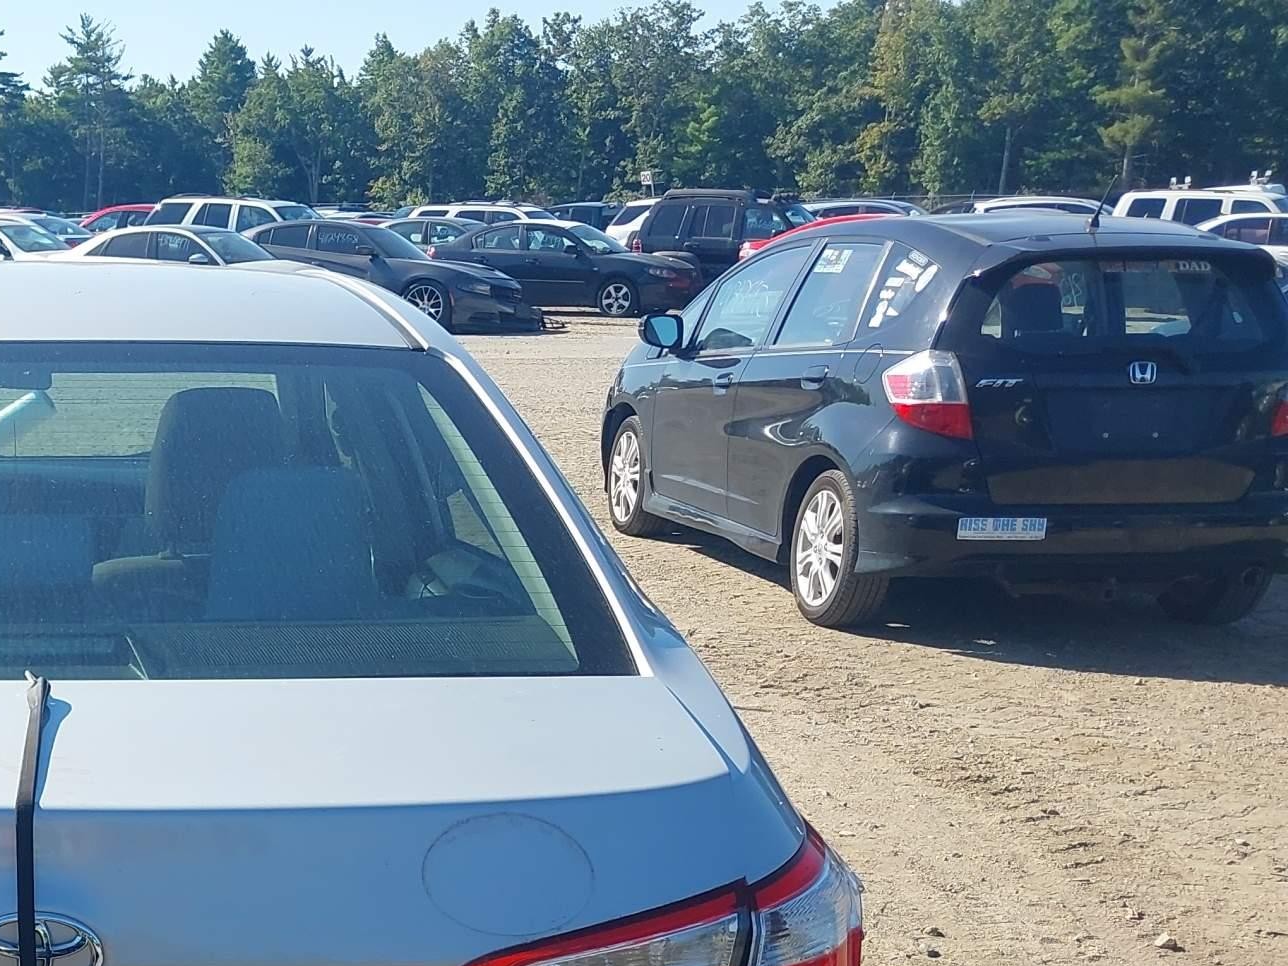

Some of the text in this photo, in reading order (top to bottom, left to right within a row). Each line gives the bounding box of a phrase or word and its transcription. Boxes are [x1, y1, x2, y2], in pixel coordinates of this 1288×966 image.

[1178, 261, 1211, 272] DAD
[975, 378, 1023, 388] FIT
[991, 518, 1017, 531] THE
